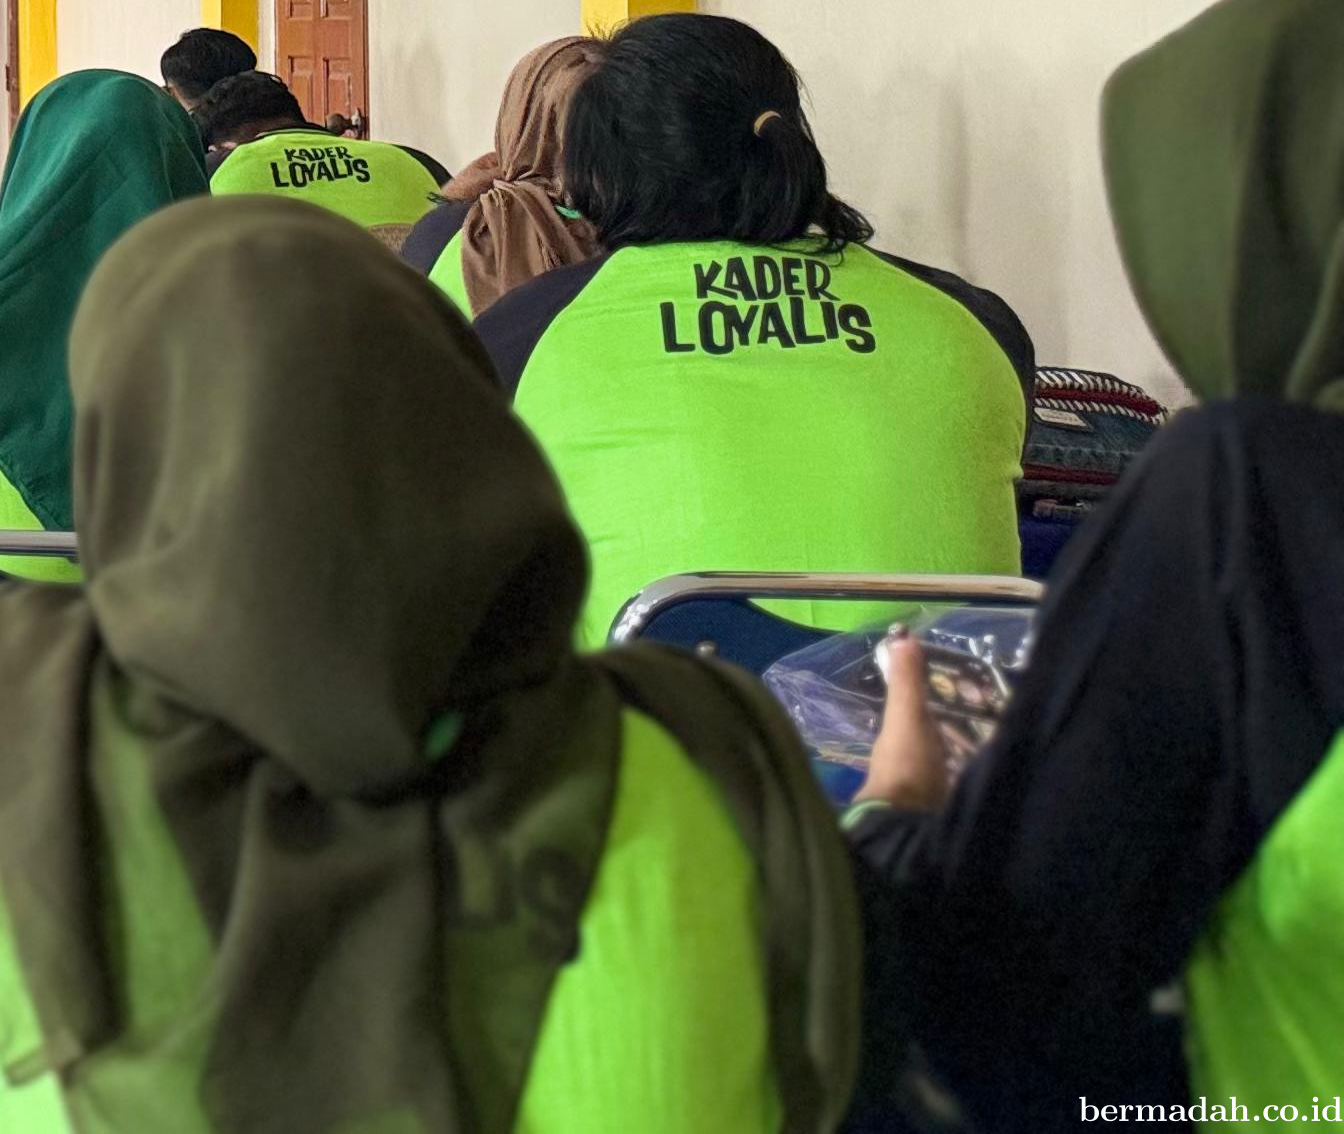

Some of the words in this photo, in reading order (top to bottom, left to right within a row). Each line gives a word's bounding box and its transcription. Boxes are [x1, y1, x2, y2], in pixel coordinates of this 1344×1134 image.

[269, 158, 371, 188] LOYALIS
[283, 146, 354, 162] KADER
[693, 255, 842, 302] KADER
[659, 296, 877, 355] LOYALIS
